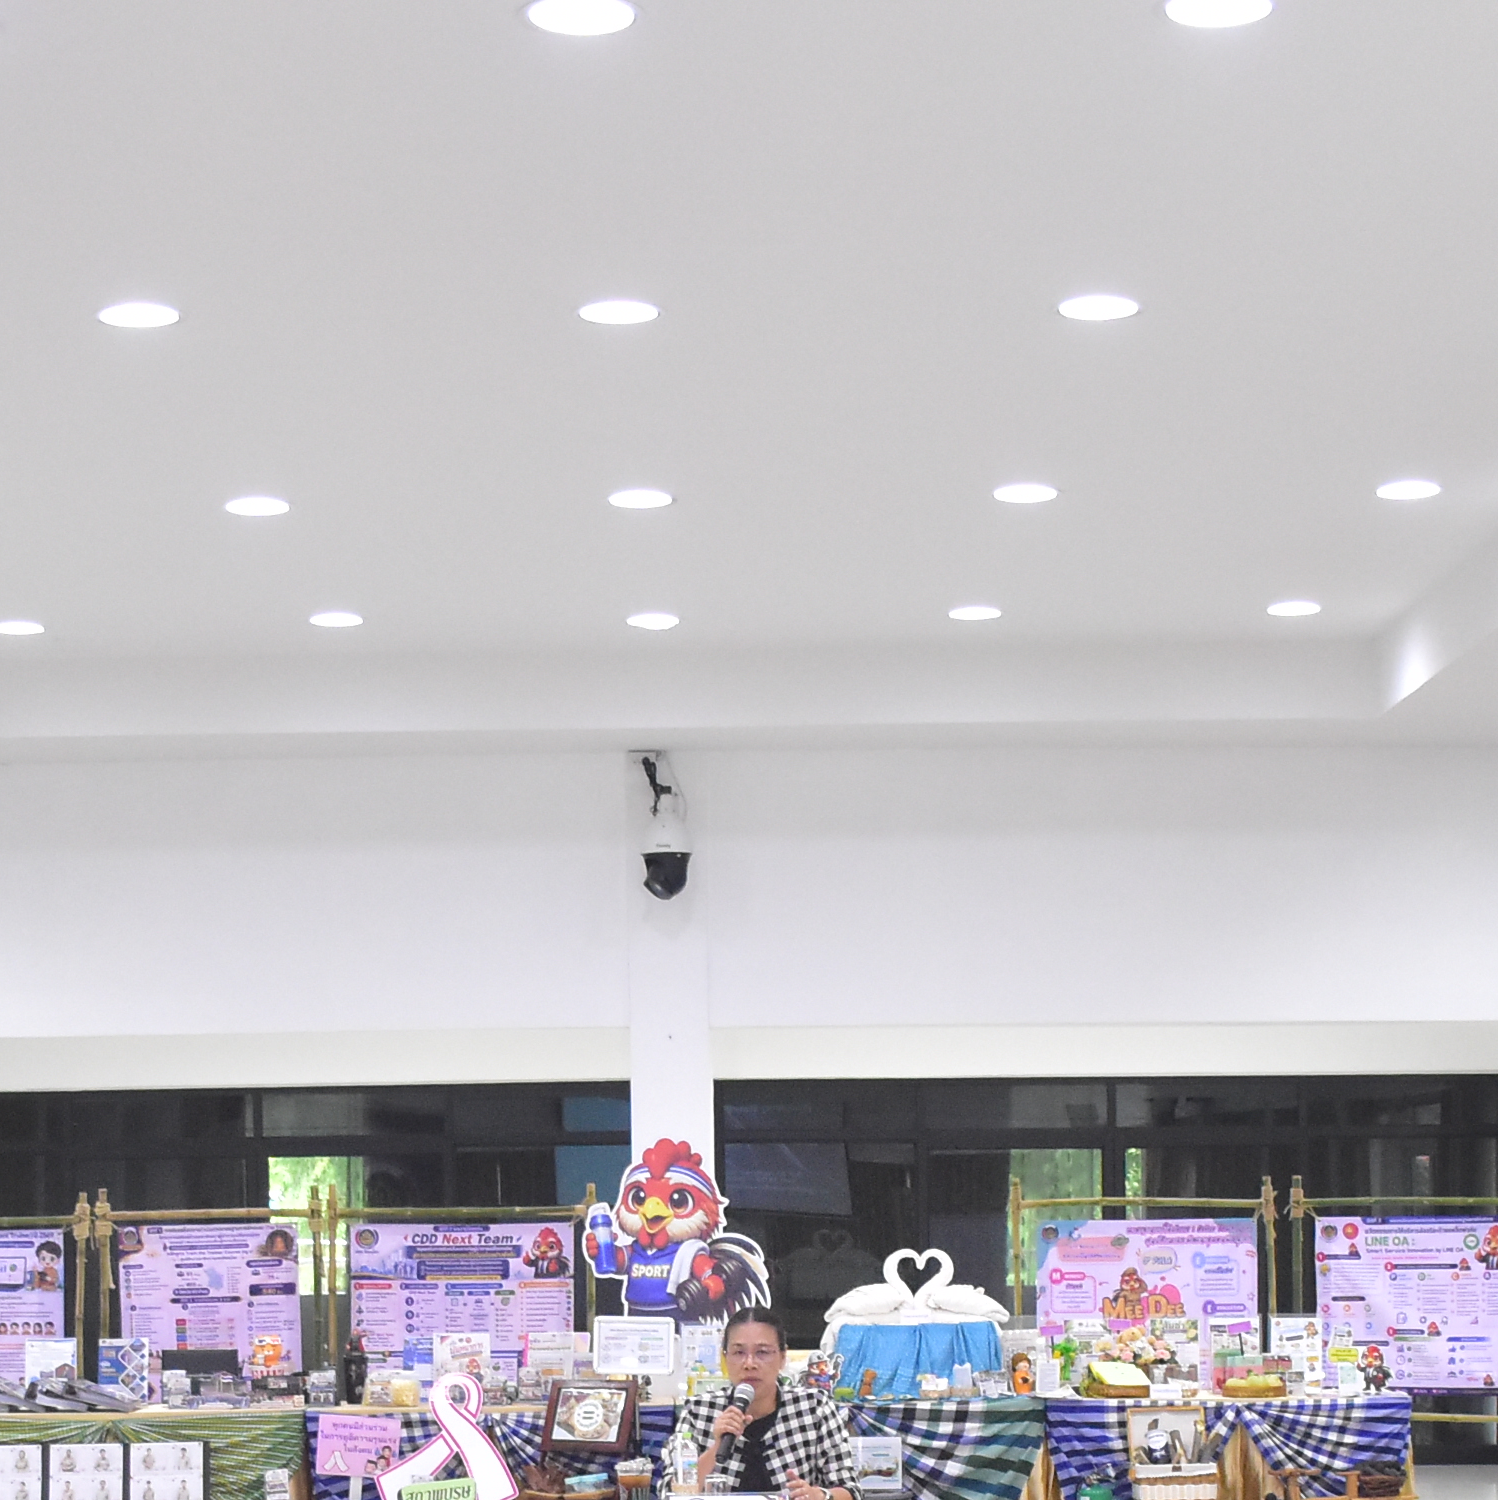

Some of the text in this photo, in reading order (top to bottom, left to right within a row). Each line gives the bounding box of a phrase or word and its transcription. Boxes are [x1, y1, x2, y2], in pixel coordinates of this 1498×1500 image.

[411, 1233, 514, 1245] CDD Next Team
[1364, 1236, 1389, 1246] LINE
[1392, 1236, 1409, 1246] OA
[632, 1263, 670, 1278] SPORT
